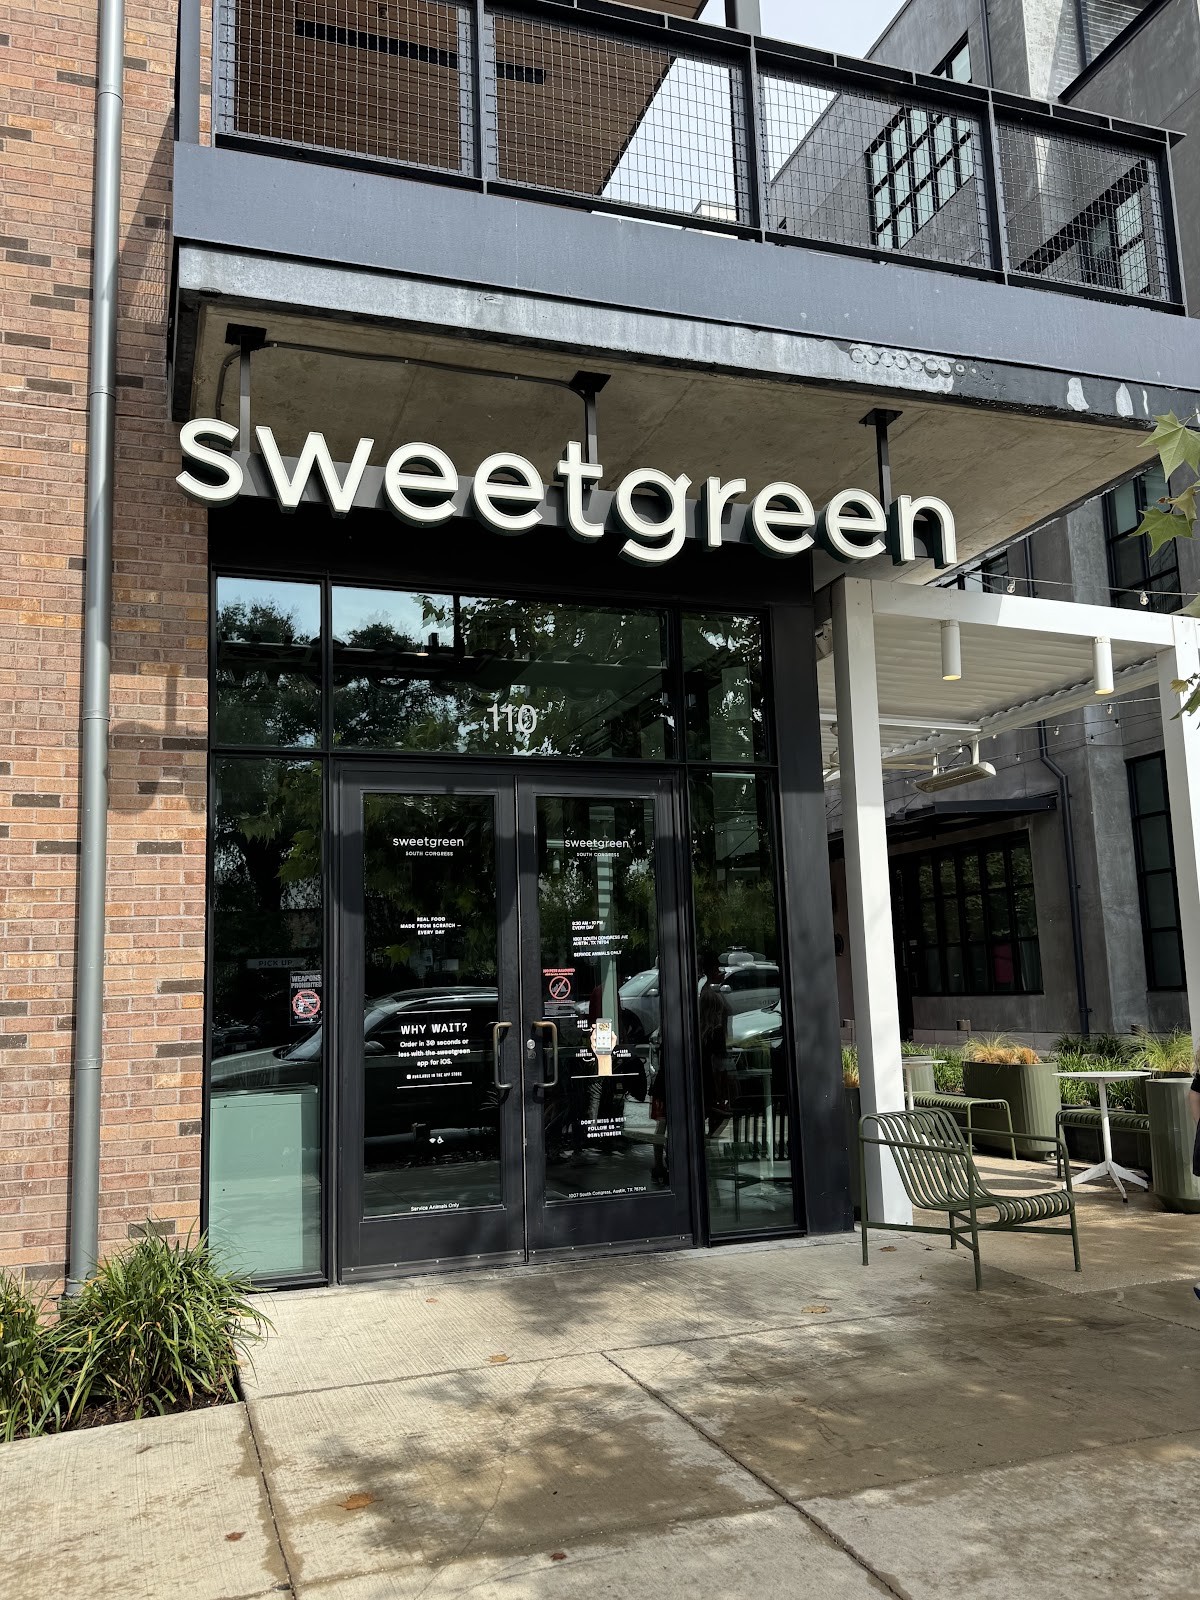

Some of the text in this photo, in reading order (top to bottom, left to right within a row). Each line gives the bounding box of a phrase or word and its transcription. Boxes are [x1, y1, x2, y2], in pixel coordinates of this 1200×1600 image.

[175, 417, 958, 567] sweetgreen
[487, 703, 538, 734] 110
[392, 837, 464, 848] sweetgreen
[565, 839, 629, 849] sweetgreen
[400, 1022, 468, 1035] WHY WAIT?
[410, 1049, 424, 1057] with
[436, 1048, 471, 1056] sweetgreen
[416, 1060, 429, 1068] app
